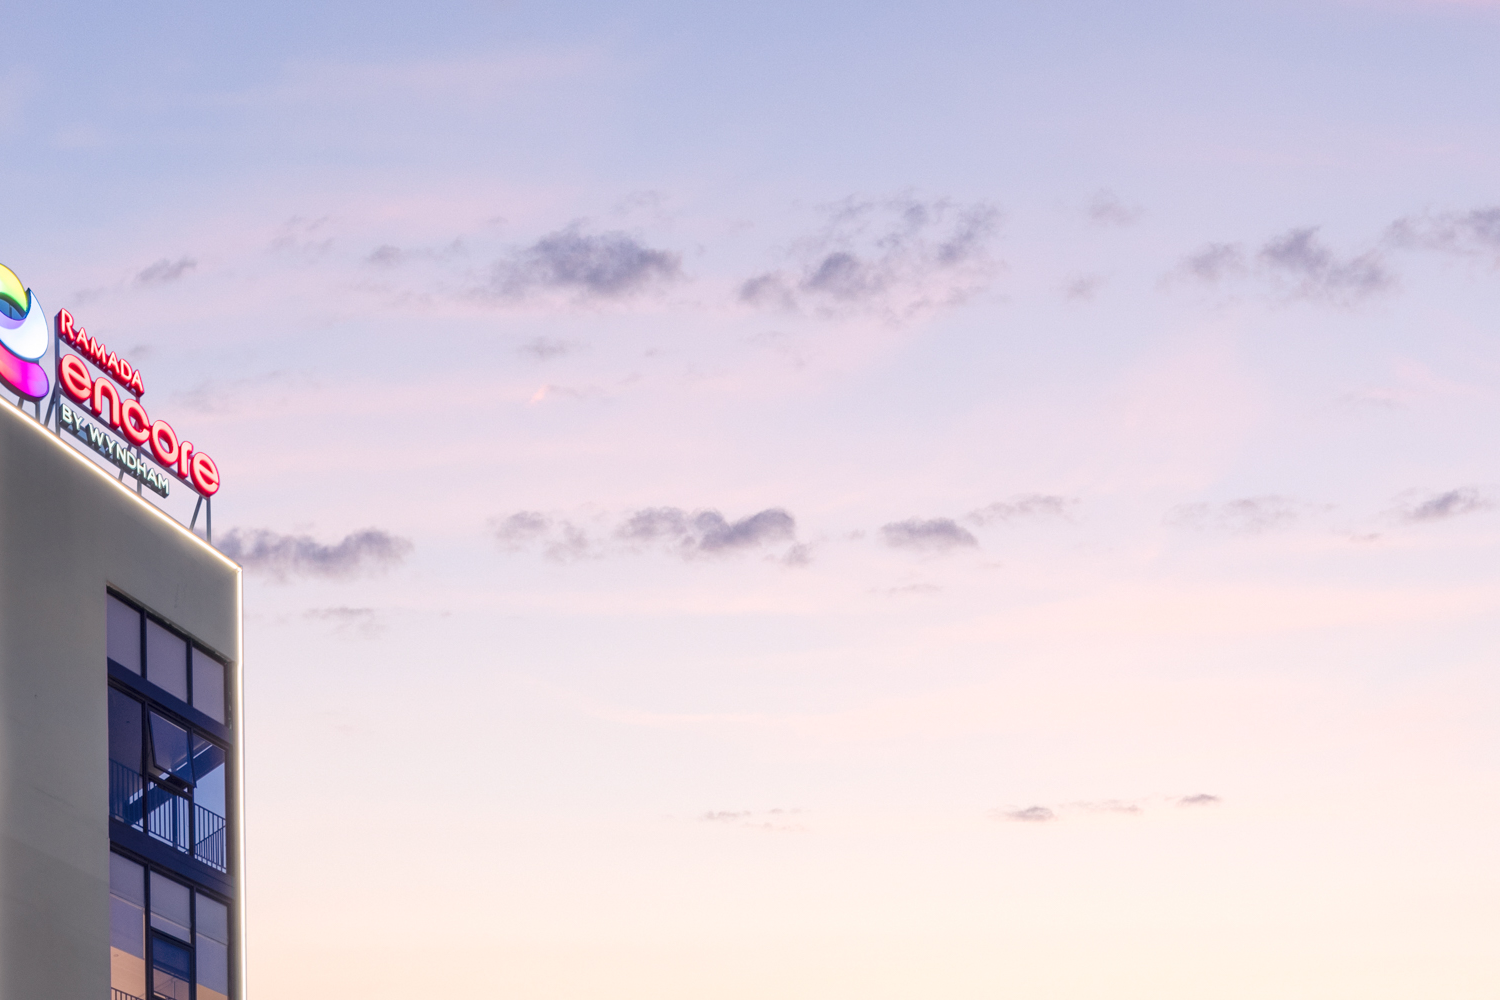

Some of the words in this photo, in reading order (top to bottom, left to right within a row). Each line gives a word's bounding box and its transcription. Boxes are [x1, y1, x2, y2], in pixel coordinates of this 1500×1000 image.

[59, 308, 144, 395] RAMADA
[59, 354, 220, 497] encore
[61, 404, 83, 431] BY
[87, 423, 169, 496] WYNDHAM
